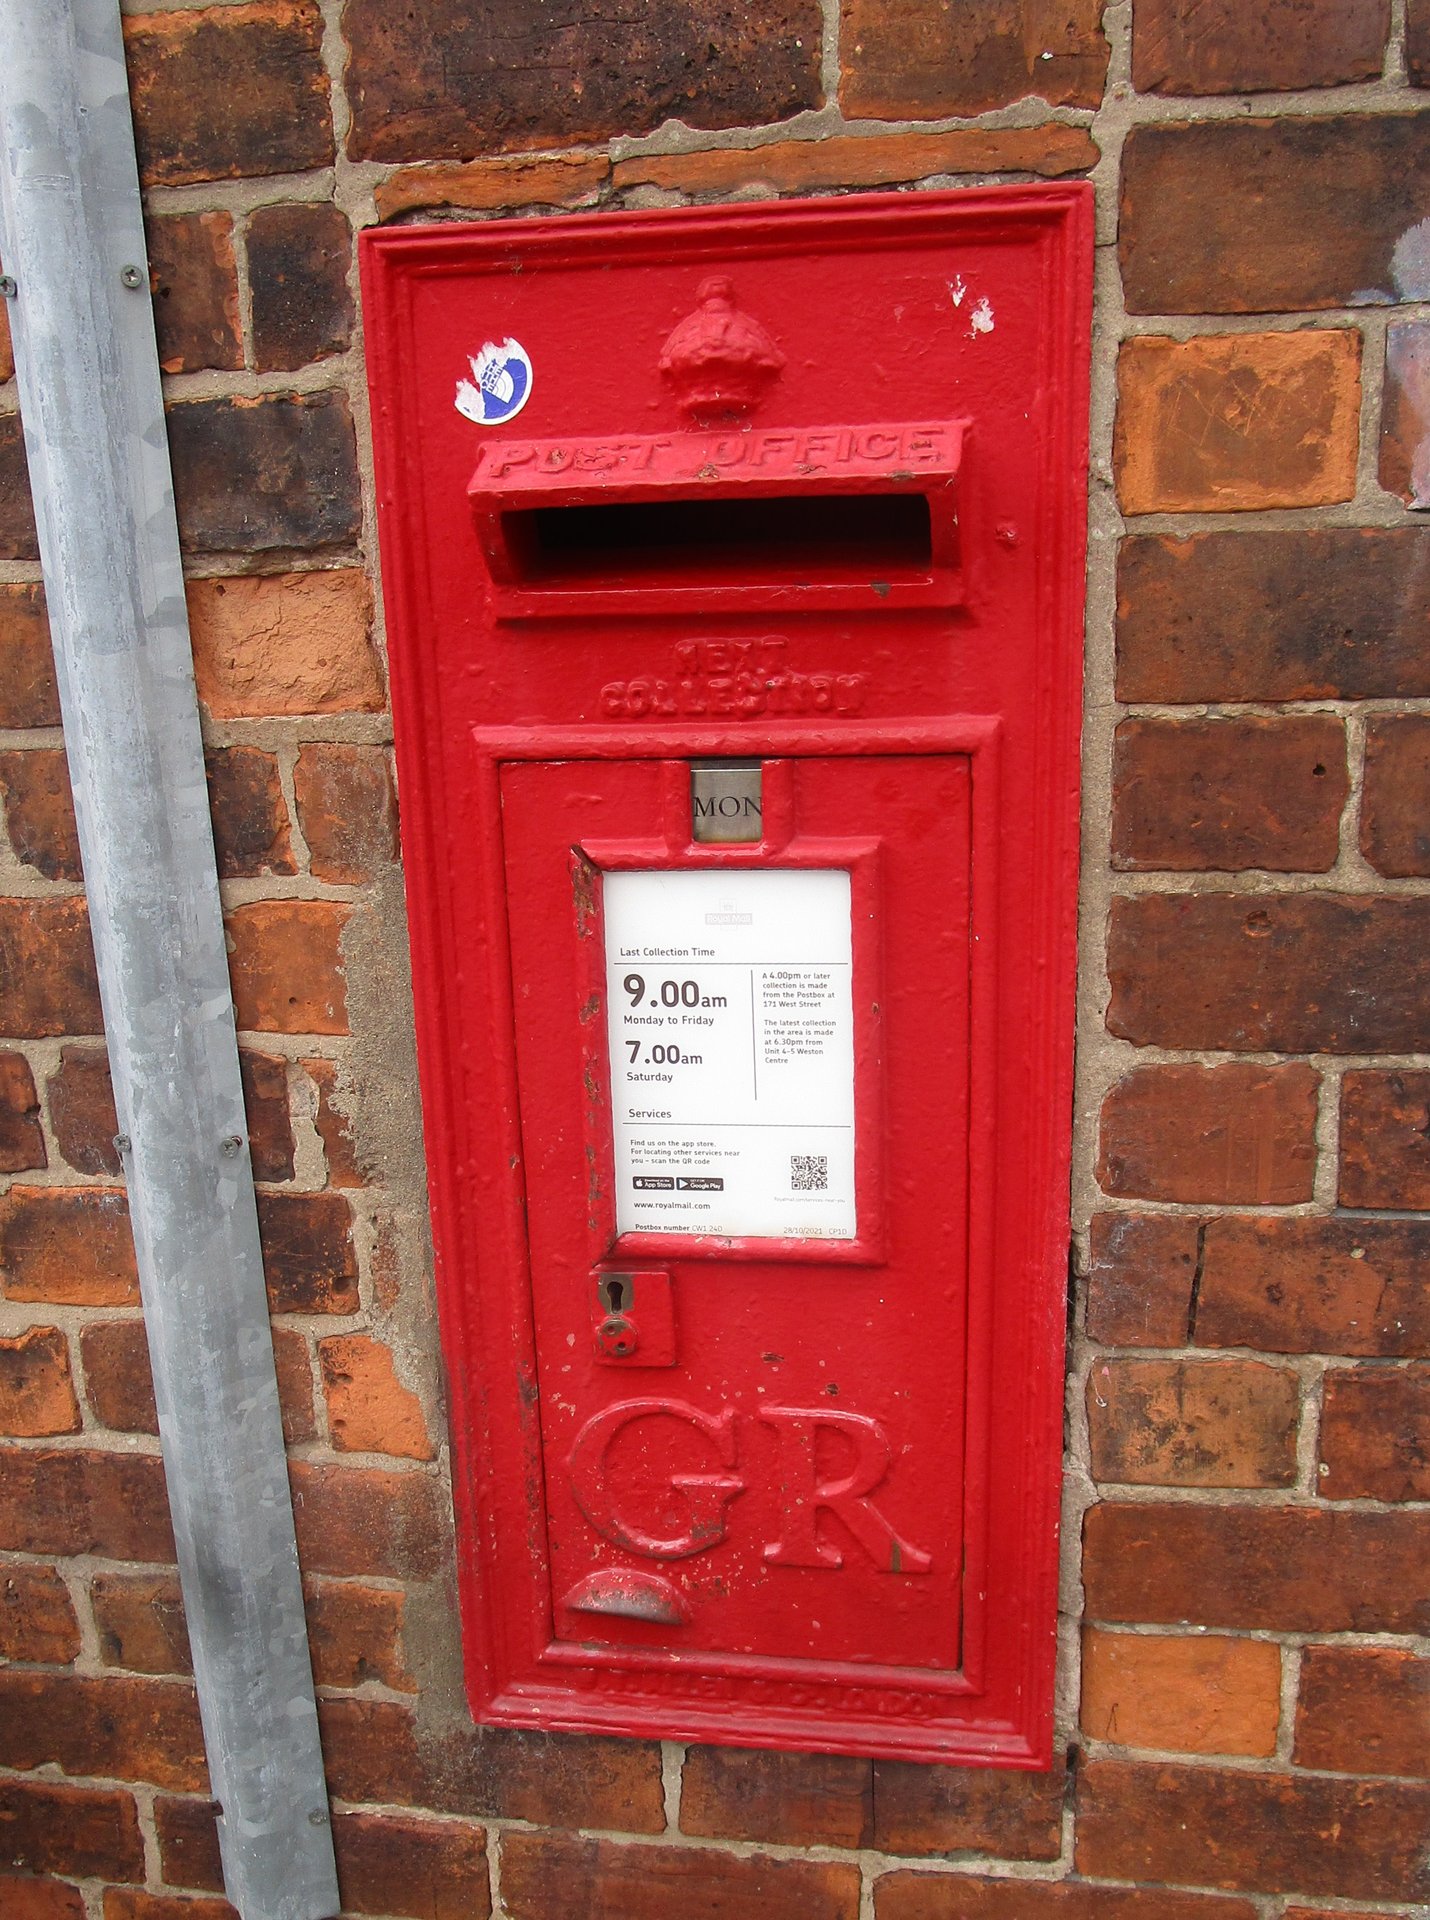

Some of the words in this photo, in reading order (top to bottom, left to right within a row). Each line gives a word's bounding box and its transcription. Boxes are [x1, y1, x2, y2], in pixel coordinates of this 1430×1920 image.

[487, 440, 671, 479] POST
[707, 427, 944, 466] OFFICE
[674, 635, 790, 676] NEXT
[692, 796, 762, 817] MON
[620, 948, 640, 956] Last
[644, 948, 689, 956] Collection
[692, 948, 715, 956] Time
[770, 972, 801, 980] 4.00pm
[624, 974, 727, 1008] 9.00am
[624, 1015, 664, 1026] Monday
[668, 1016, 678, 1024] to
[682, 1015, 714, 1026] Friday
[774, 1038, 804, 1046] 6.30pm
[625, 1040, 703, 1064] 7.00am
[626, 1072, 673, 1083] Saturday
[628, 1108, 672, 1118] Services
[644, 1148, 672, 1156] locating
[784, 1227, 822, 1235] 28/10/2021
[567, 1397, 931, 1572] GR
